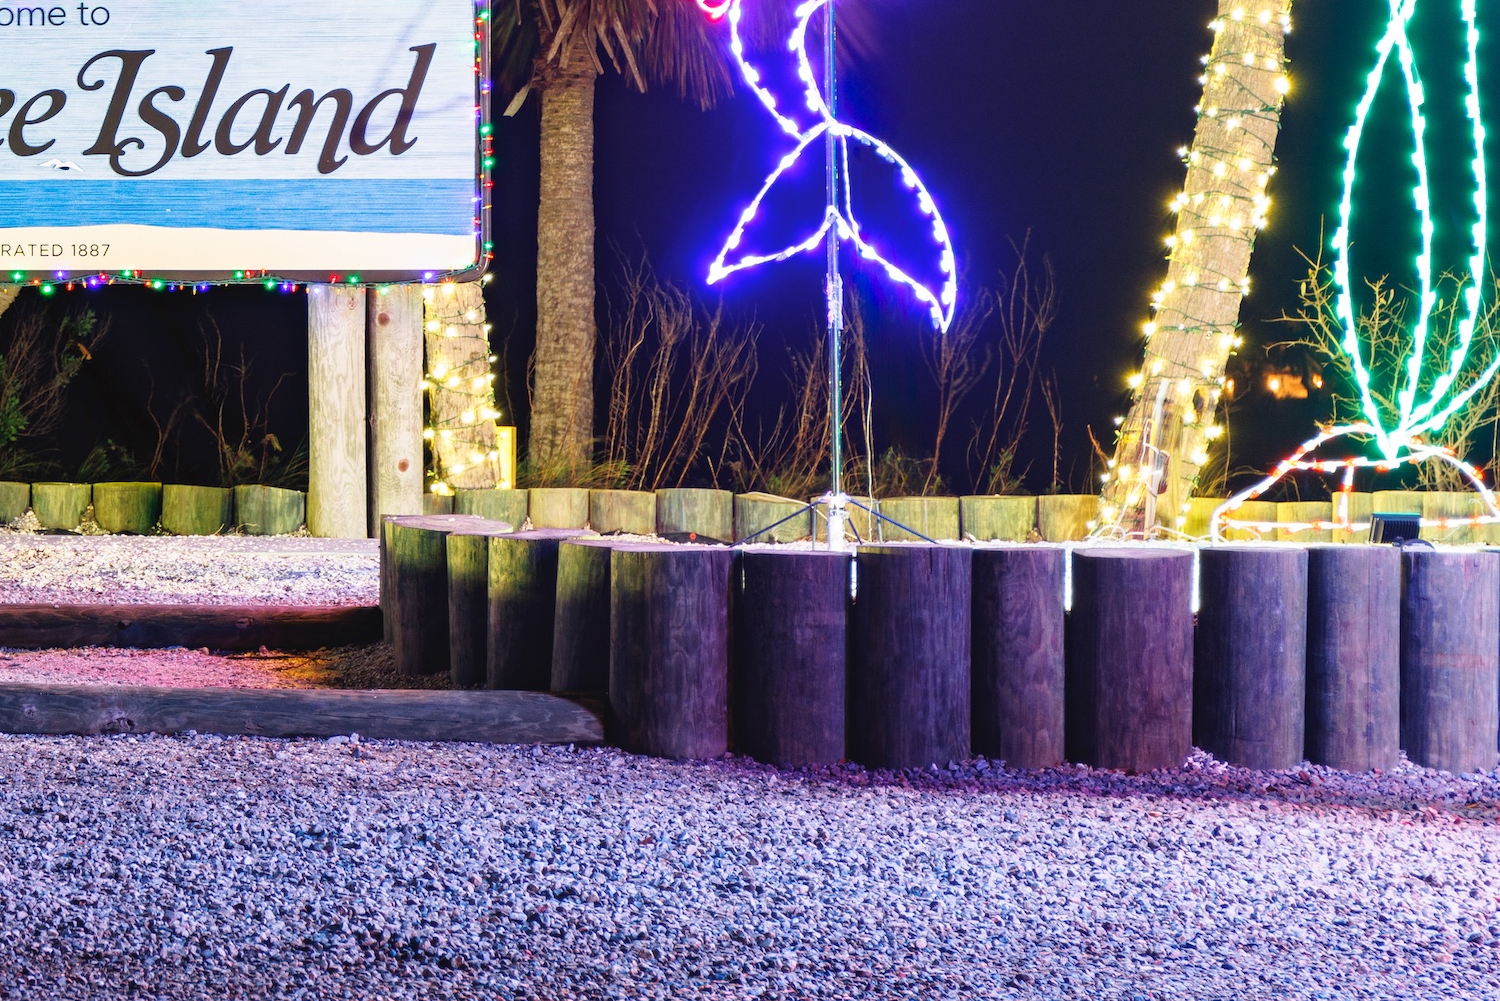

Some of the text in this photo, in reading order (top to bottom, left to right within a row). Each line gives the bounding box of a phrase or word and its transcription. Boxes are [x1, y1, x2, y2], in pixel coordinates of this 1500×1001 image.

[76, 2, 111, 26] to
[77, 42, 439, 178] Island
[71, 243, 111, 257] 1887
